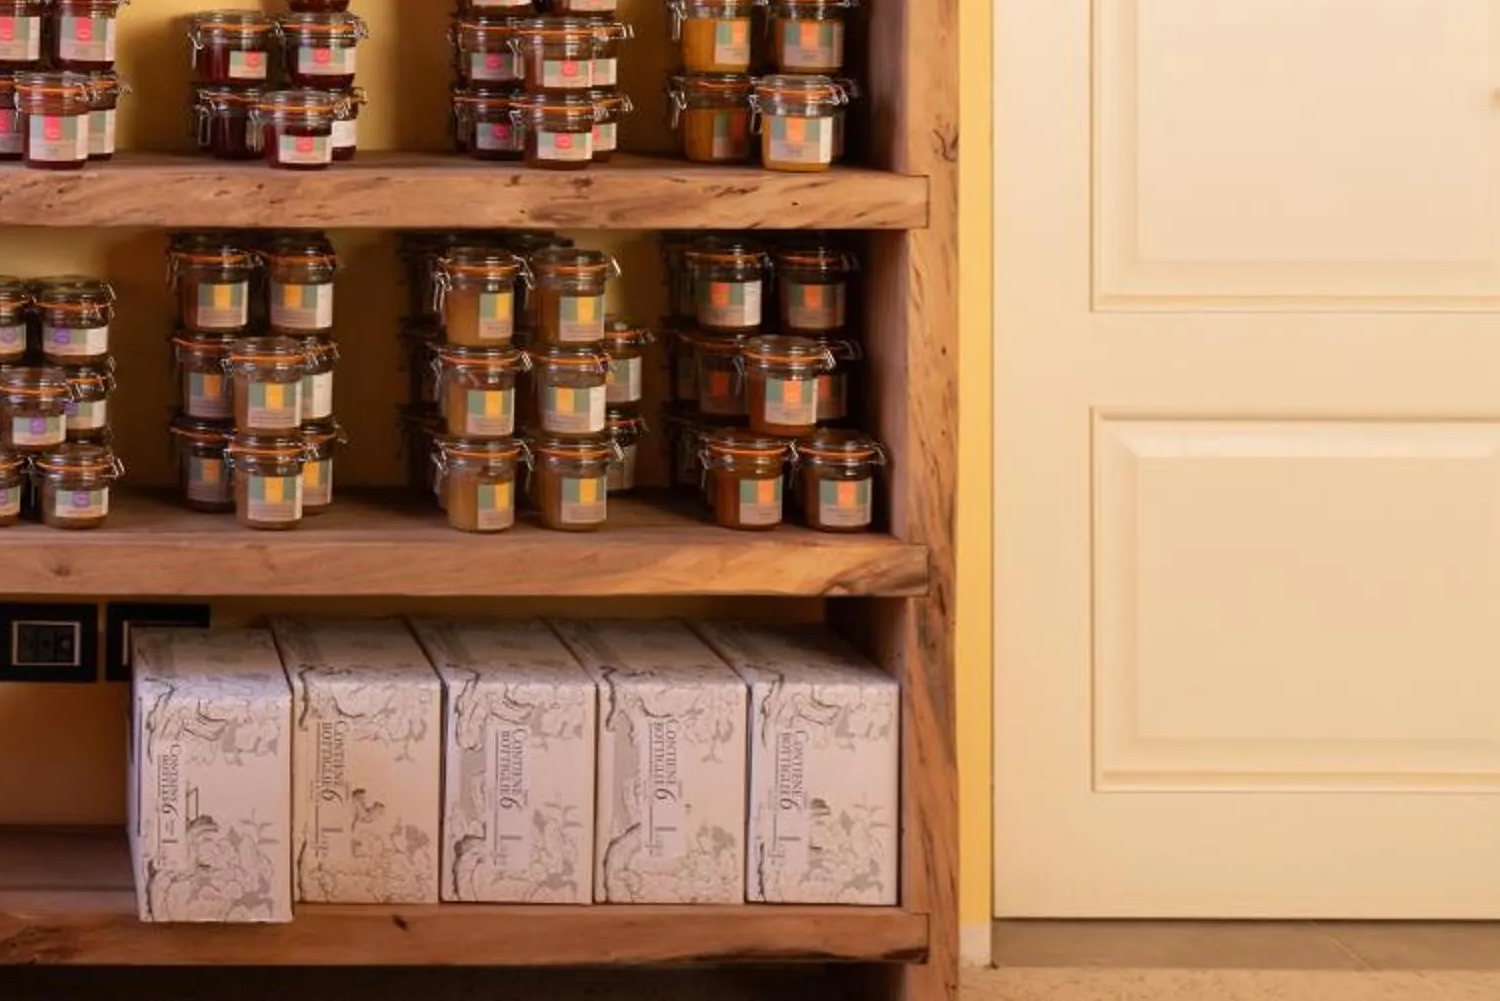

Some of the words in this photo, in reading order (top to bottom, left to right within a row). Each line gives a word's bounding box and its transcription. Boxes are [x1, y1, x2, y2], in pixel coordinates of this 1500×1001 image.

[322, 788, 344, 806] 6
[654, 787, 677, 803] 6
[500, 796, 522, 811] 6
[780, 798, 801, 811] 6
